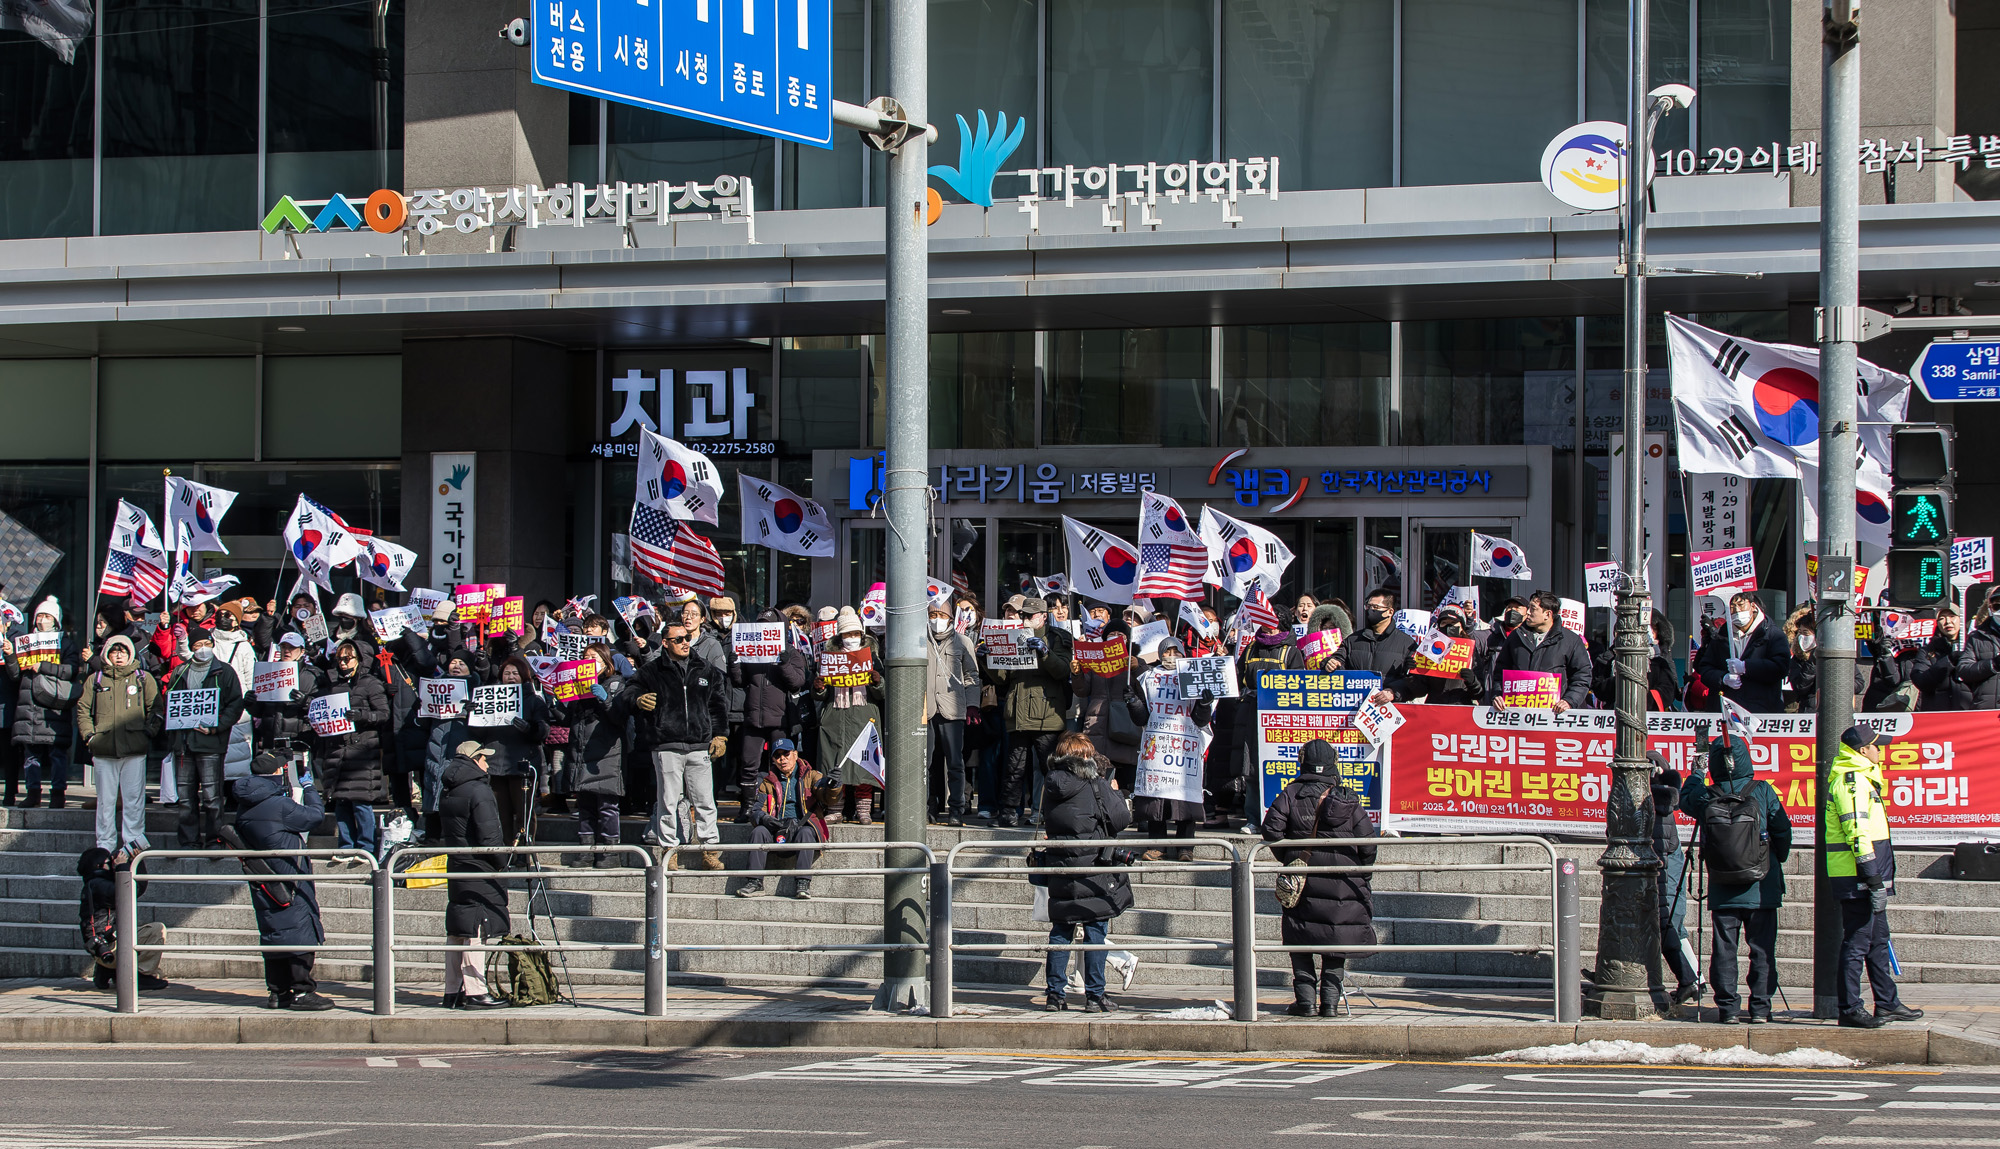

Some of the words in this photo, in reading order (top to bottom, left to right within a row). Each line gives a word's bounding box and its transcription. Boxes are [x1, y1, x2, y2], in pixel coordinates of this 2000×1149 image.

[550, 1, 585, 32] 버스
[551, 37, 585, 72] 전용
[614, 34, 649, 70] 시청
[675, 49, 708, 85] 시청
[732, 62, 765, 97] 종로
[787, 76, 818, 110] 종로
[1018, 156, 1279, 230] 국가인권위원회
[411, 175, 753, 235] 중앙사회서비스원
[1966, 347, 2000, 366] 삼일
[1931, 365, 1956, 378] 338
[1958, 388, 1997, 397] 三一大路
[611, 367, 755, 440] 치과
[692, 443, 776, 455] 02-2275-2580
[1080, 472, 1157, 495] 저동빌딩
[1226, 469, 1291, 507] 캠코
[1320, 470, 1493, 494] 한국자산관리공사
[1702, 490, 1717, 549] 재발방지
[1693, 558, 1733, 576] 하이브리드
[1735, 552, 1752, 566] 전쟁
[1695, 572, 1723, 587] 국민이
[1724, 564, 1752, 579] 싸운다
[1920, 557, 1943, 598] 8
[504, 600, 523, 615] 인권
[735, 632, 742, 642] 윤
[742, 632, 762, 641] 대통령
[763, 629, 781, 641] 인권
[1104, 641, 1125, 658] 인권
[1450, 643, 1471, 658] 인권
[821, 653, 851, 665] 방어권,
[852, 660, 872, 673] 수사
[993, 657, 1034, 666] 싸우겠습니다
[254, 667, 294, 684] 자유민주주의
[577, 662, 596, 679] 인권
[1191, 673, 1225, 685] 고도의
[427, 683, 455, 694] STOP
[1261, 674, 1344, 690] 이충상·김용원
[1346, 679, 1382, 689] 상임위원
[1512, 680, 1537, 692] 대통령
[1537, 676, 1560, 692] 인권
[169, 690, 217, 704] 부정선거
[431, 694, 451, 704] THE
[474, 686, 520, 701] 부정선거
[1277, 692, 1303, 708] 공격
[169, 703, 217, 718] 검증하라
[428, 704, 459, 714] STEAL
[474, 700, 520, 715] 검증하라
[1364, 704, 1385, 725] THE
[1486, 711, 1521, 726] 인권은
[1525, 712, 1549, 727] 어느
[1799, 719, 1813, 733] 앞
[1171, 738, 1198, 752] CCP
[1431, 733, 1546, 766] 인권위는
[1556, 738, 1614, 768] 윤석
[1163, 754, 1197, 769] OUT!
[1427, 768, 1512, 799] 방어권
[1400, 801, 1414, 811] 일시
[1423, 802, 1445, 812] 2025.
[1447, 800, 1458, 812] 2.
[1461, 801, 1488, 814] 10(월)
[1490, 804, 1505, 815] 오전
[1507, 803, 1527, 816] 11시
[1529, 804, 1553, 817] 30분
[1558, 807, 1574, 817] 장소
[1582, 808, 1607, 819] 국가인
